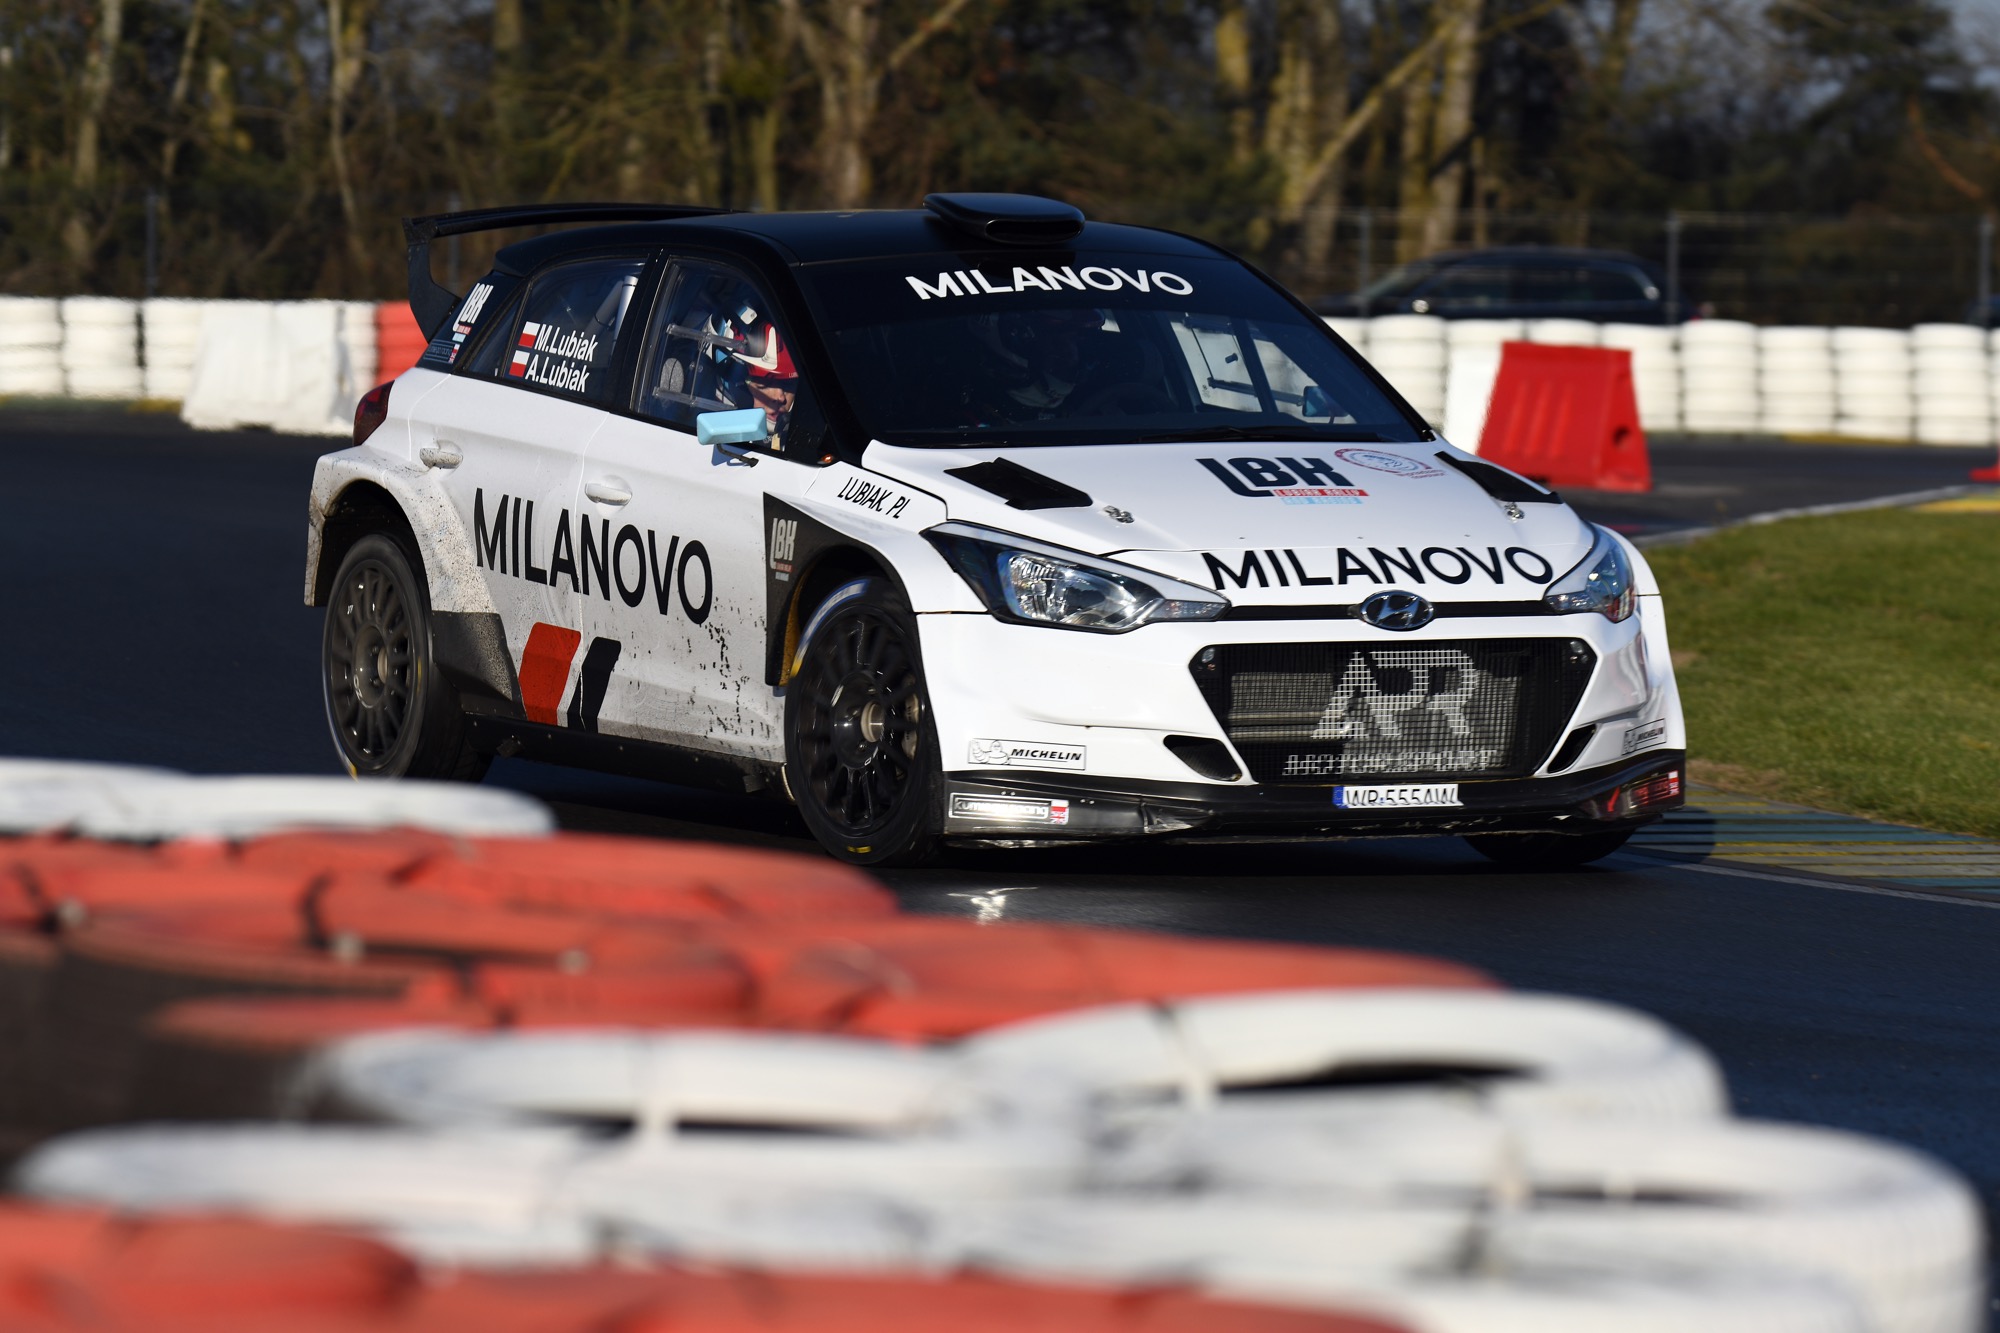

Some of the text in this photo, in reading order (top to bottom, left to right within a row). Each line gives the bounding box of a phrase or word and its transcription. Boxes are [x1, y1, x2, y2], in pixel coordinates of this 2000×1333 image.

[905, 266, 1193, 299] MILANOVO
[452, 282, 494, 332] LBK
[534, 323, 598, 362] M.Lubiak
[524, 354, 590, 392] A.Lubiak
[1195, 457, 1355, 497] LBK
[474, 487, 713, 625] MILANOVO
[770, 517, 797, 570] LBK
[1201, 546, 1553, 591] MILANOVO
[1310, 650, 1477, 739] APR
[1010, 748, 1082, 761] MICHELIN
[1345, 786, 1456, 806] WR 555AW
